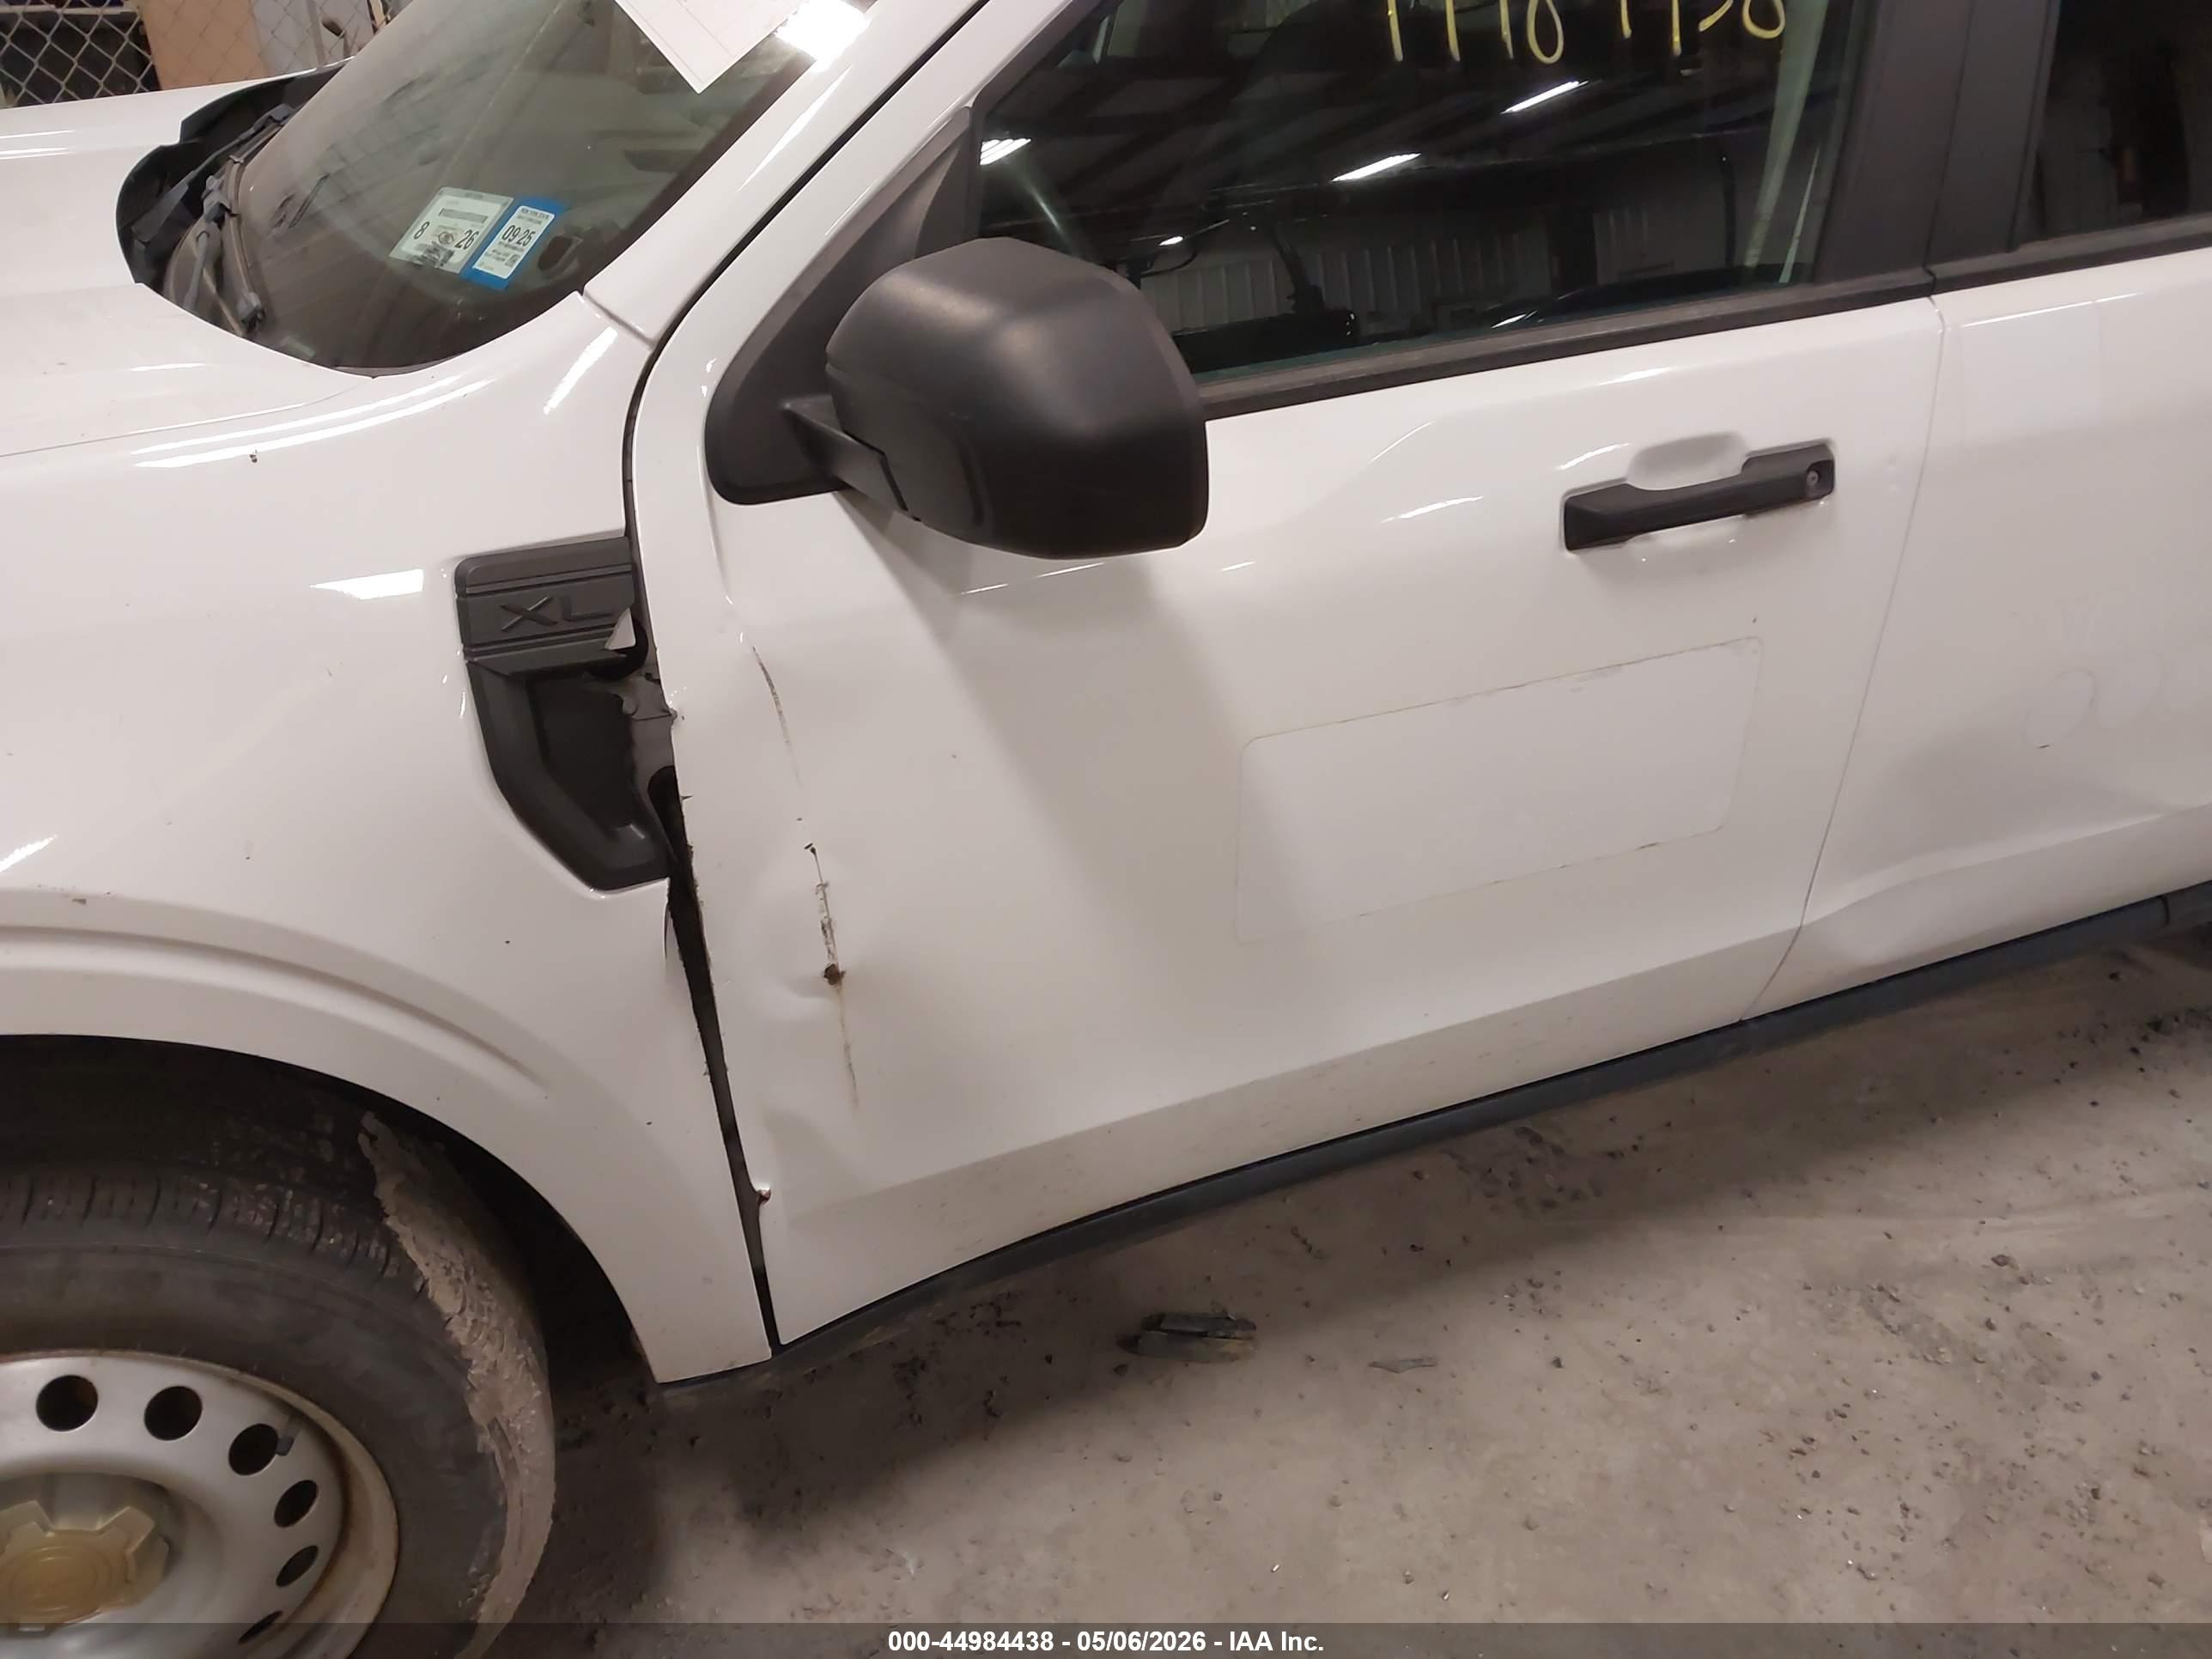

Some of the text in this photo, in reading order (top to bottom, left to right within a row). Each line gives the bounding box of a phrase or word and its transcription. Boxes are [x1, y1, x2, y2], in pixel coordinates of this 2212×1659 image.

[413, 221, 430, 240] 8
[453, 228, 480, 251] 26
[499, 594, 615, 633] XL
